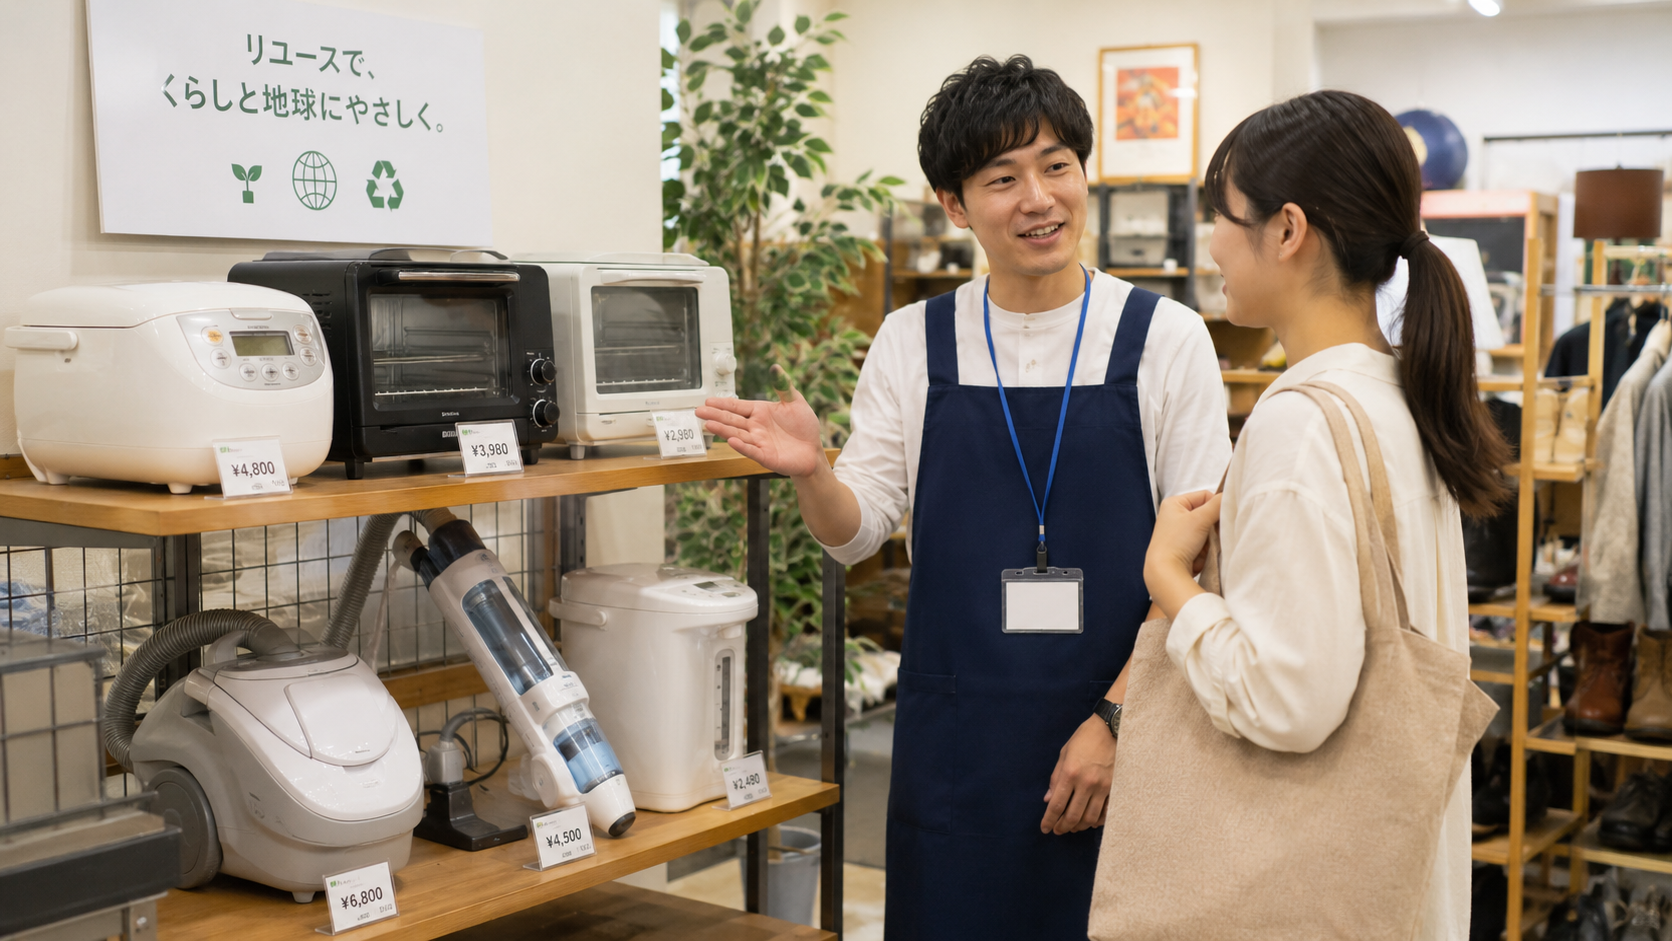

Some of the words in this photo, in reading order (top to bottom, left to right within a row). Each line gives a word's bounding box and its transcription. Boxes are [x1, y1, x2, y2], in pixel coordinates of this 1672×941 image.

[246, 33, 375, 79] リユースで、
[161, 73, 443, 133] くらしと地球にやさしく。
[664, 428, 695, 442] ¥2,980
[471, 442, 509, 458] ¥3,980
[231, 460, 275, 478] ¥4,800
[546, 827, 582, 848] ¥4,500
[341, 886, 383, 910] ¥6,800
